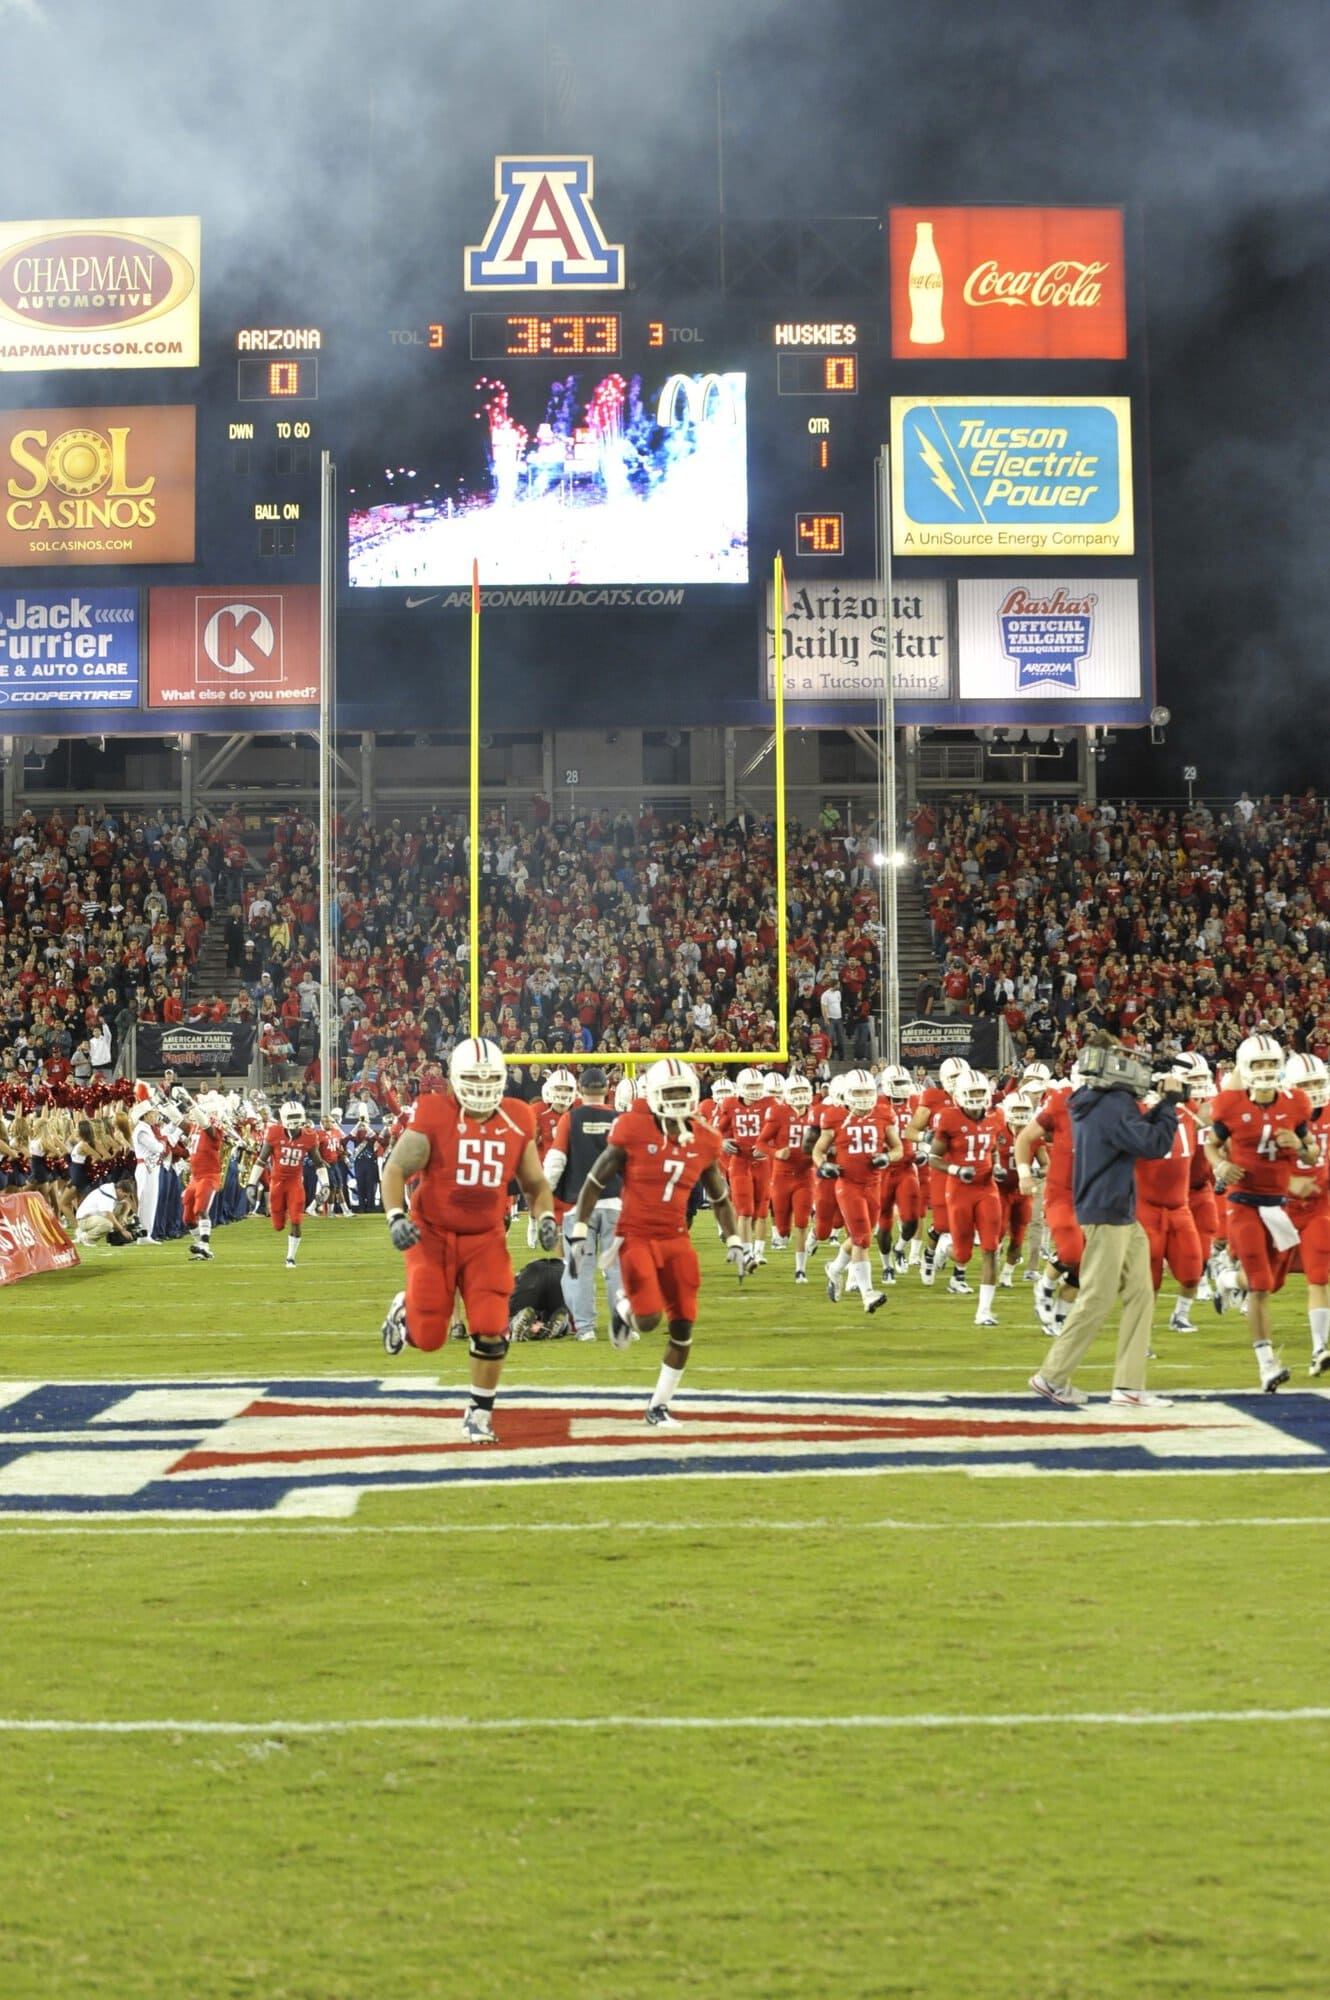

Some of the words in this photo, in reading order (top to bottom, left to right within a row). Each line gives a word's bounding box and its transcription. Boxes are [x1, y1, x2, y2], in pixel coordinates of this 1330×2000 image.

[13, 255, 155, 294] CHAPMAN
[963, 260, 1110, 307] Coca-Cola
[17, 293, 153, 309] AUTOMOTIVE
[238, 329, 321, 350] ARIZONA
[388, 330, 423, 345] TOL
[429, 325, 443, 348] 3
[507, 317, 617, 353] 3:33
[649, 323, 663, 346] 3
[669, 328, 704, 343] TOL
[775, 324, 857, 345] HUSKIES
[270, 363, 298, 394] 0
[826, 357, 854, 389] 0
[229, 423, 254, 439] DWN
[276, 422, 291, 438] TO
[294, 422, 310, 438] GO
[808, 417, 830, 434] QTR
[958, 420, 1067, 449] Tucson
[7, 427, 155, 498] SOL
[821, 440, 828, 467] 1
[969, 450, 1098, 477] Electric
[983, 479, 1099, 507] Power
[6, 498, 156, 530] CASINOS
[255, 504, 280, 520] BALL
[283, 503, 299, 520] ON
[800, 518, 840, 550] 40
[904, 532, 915, 544] A
[920, 532, 993, 545] UniSource
[998, 531, 1048, 548] Energy
[1052, 531, 1120, 548] Company
[30, 540, 133, 551] SOLCASINOS.COM
[442, 589, 684, 608] ARZONAWILDCATS.COM
[6, 598, 93, 630] Jack
[1008, 620, 1085, 632] OFFICIAL
[1008, 633, 1085, 645] TAILGATE
[1008, 645, 1085, 655] HEADQUARTERS
[14, 664, 27, 677] &
[32, 663, 78, 676] AUTO
[83, 662, 128, 675] CARE
[1022, 663, 1073, 673] ARIZONA
[803, 678, 812, 689] a
[820, 673, 884, 689] Tucson
[161, 689, 195, 701] What
[199, 689, 225, 700] else
[229, 688, 247, 700] do
[249, 689, 273, 702] you
[275, 687, 317, 700] need?
[566, 770, 578, 784] 28
[1184, 766, 1197, 780] 29
[163, 1035, 202, 1043] AMERICAN
[204, 1035, 232, 1043] FAMILY
[902, 1028, 942, 1036] AMERICAN
[735, 1114, 761, 1137] 53
[847, 1125, 879, 1154] 33
[964, 1134, 992, 1162] 17
[1257, 1124, 1278, 1161] 4
[456, 1139, 506, 1188] 55
[662, 1159, 686, 1202] 7
